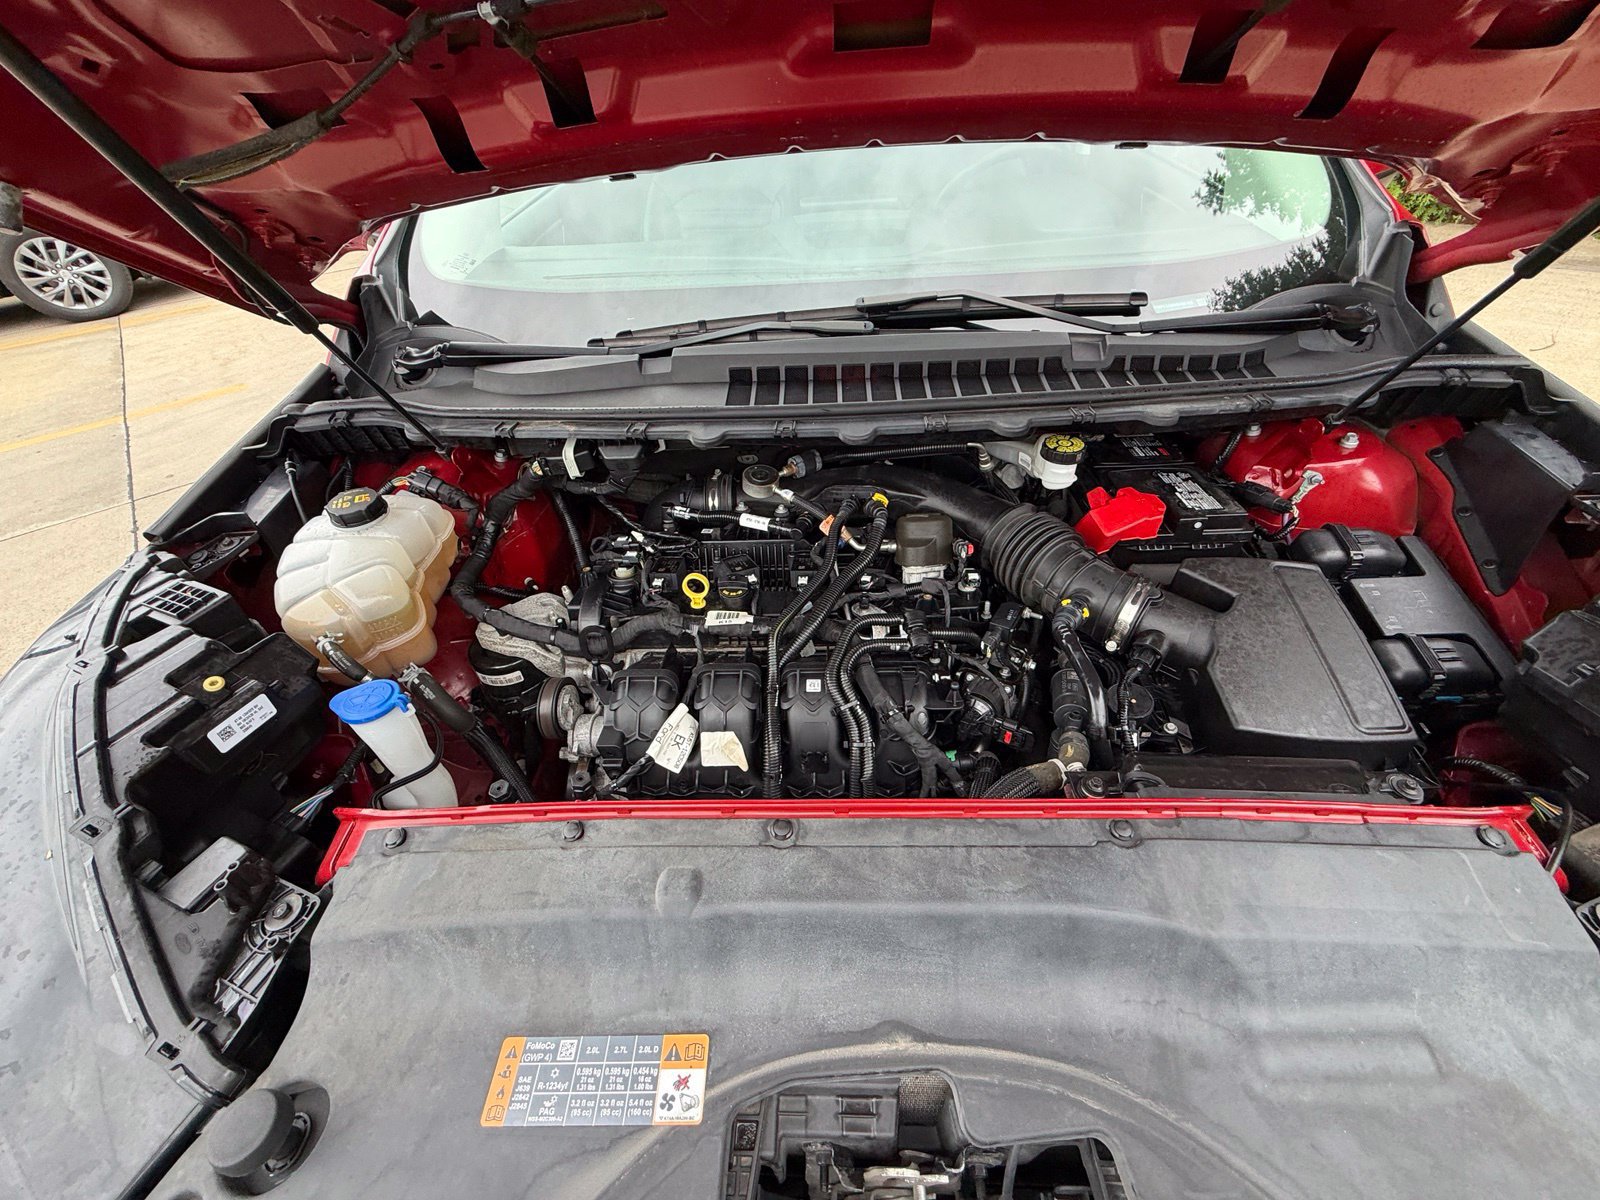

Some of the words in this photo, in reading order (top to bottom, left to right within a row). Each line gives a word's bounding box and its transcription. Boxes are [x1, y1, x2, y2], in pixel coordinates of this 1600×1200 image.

[656, 722, 674, 745] Ford
[671, 733, 686, 750] EK
[526, 1042, 556, 1050] FoMoCo
[586, 1046, 600, 1054] 2.0L
[614, 1046, 628, 1054] 2.7L
[638, 1046, 652, 1054] 2.0L
[653, 1046, 659, 1054] D
[522, 1053, 544, 1063] (GWP
[544, 1053, 552, 1063] 4)
[576, 1067, 593, 1076] 0.595
[594, 1067, 602, 1078] kg
[605, 1067, 622, 1076] 0.595
[622, 1067, 630, 1078] kg
[633, 1066, 650, 1076] 0.454
[650, 1066, 658, 1077] kg
[537, 1082, 569, 1092] R-1234yf
[570, 1099, 581, 1107] 3.2
[538, 1108, 555, 1116] PAG
[582, 1108, 592, 1118] cc)
[611, 1108, 622, 1117] cc)
[627, 1108, 642, 1117] (160
[642, 1108, 653, 1117] cc)
